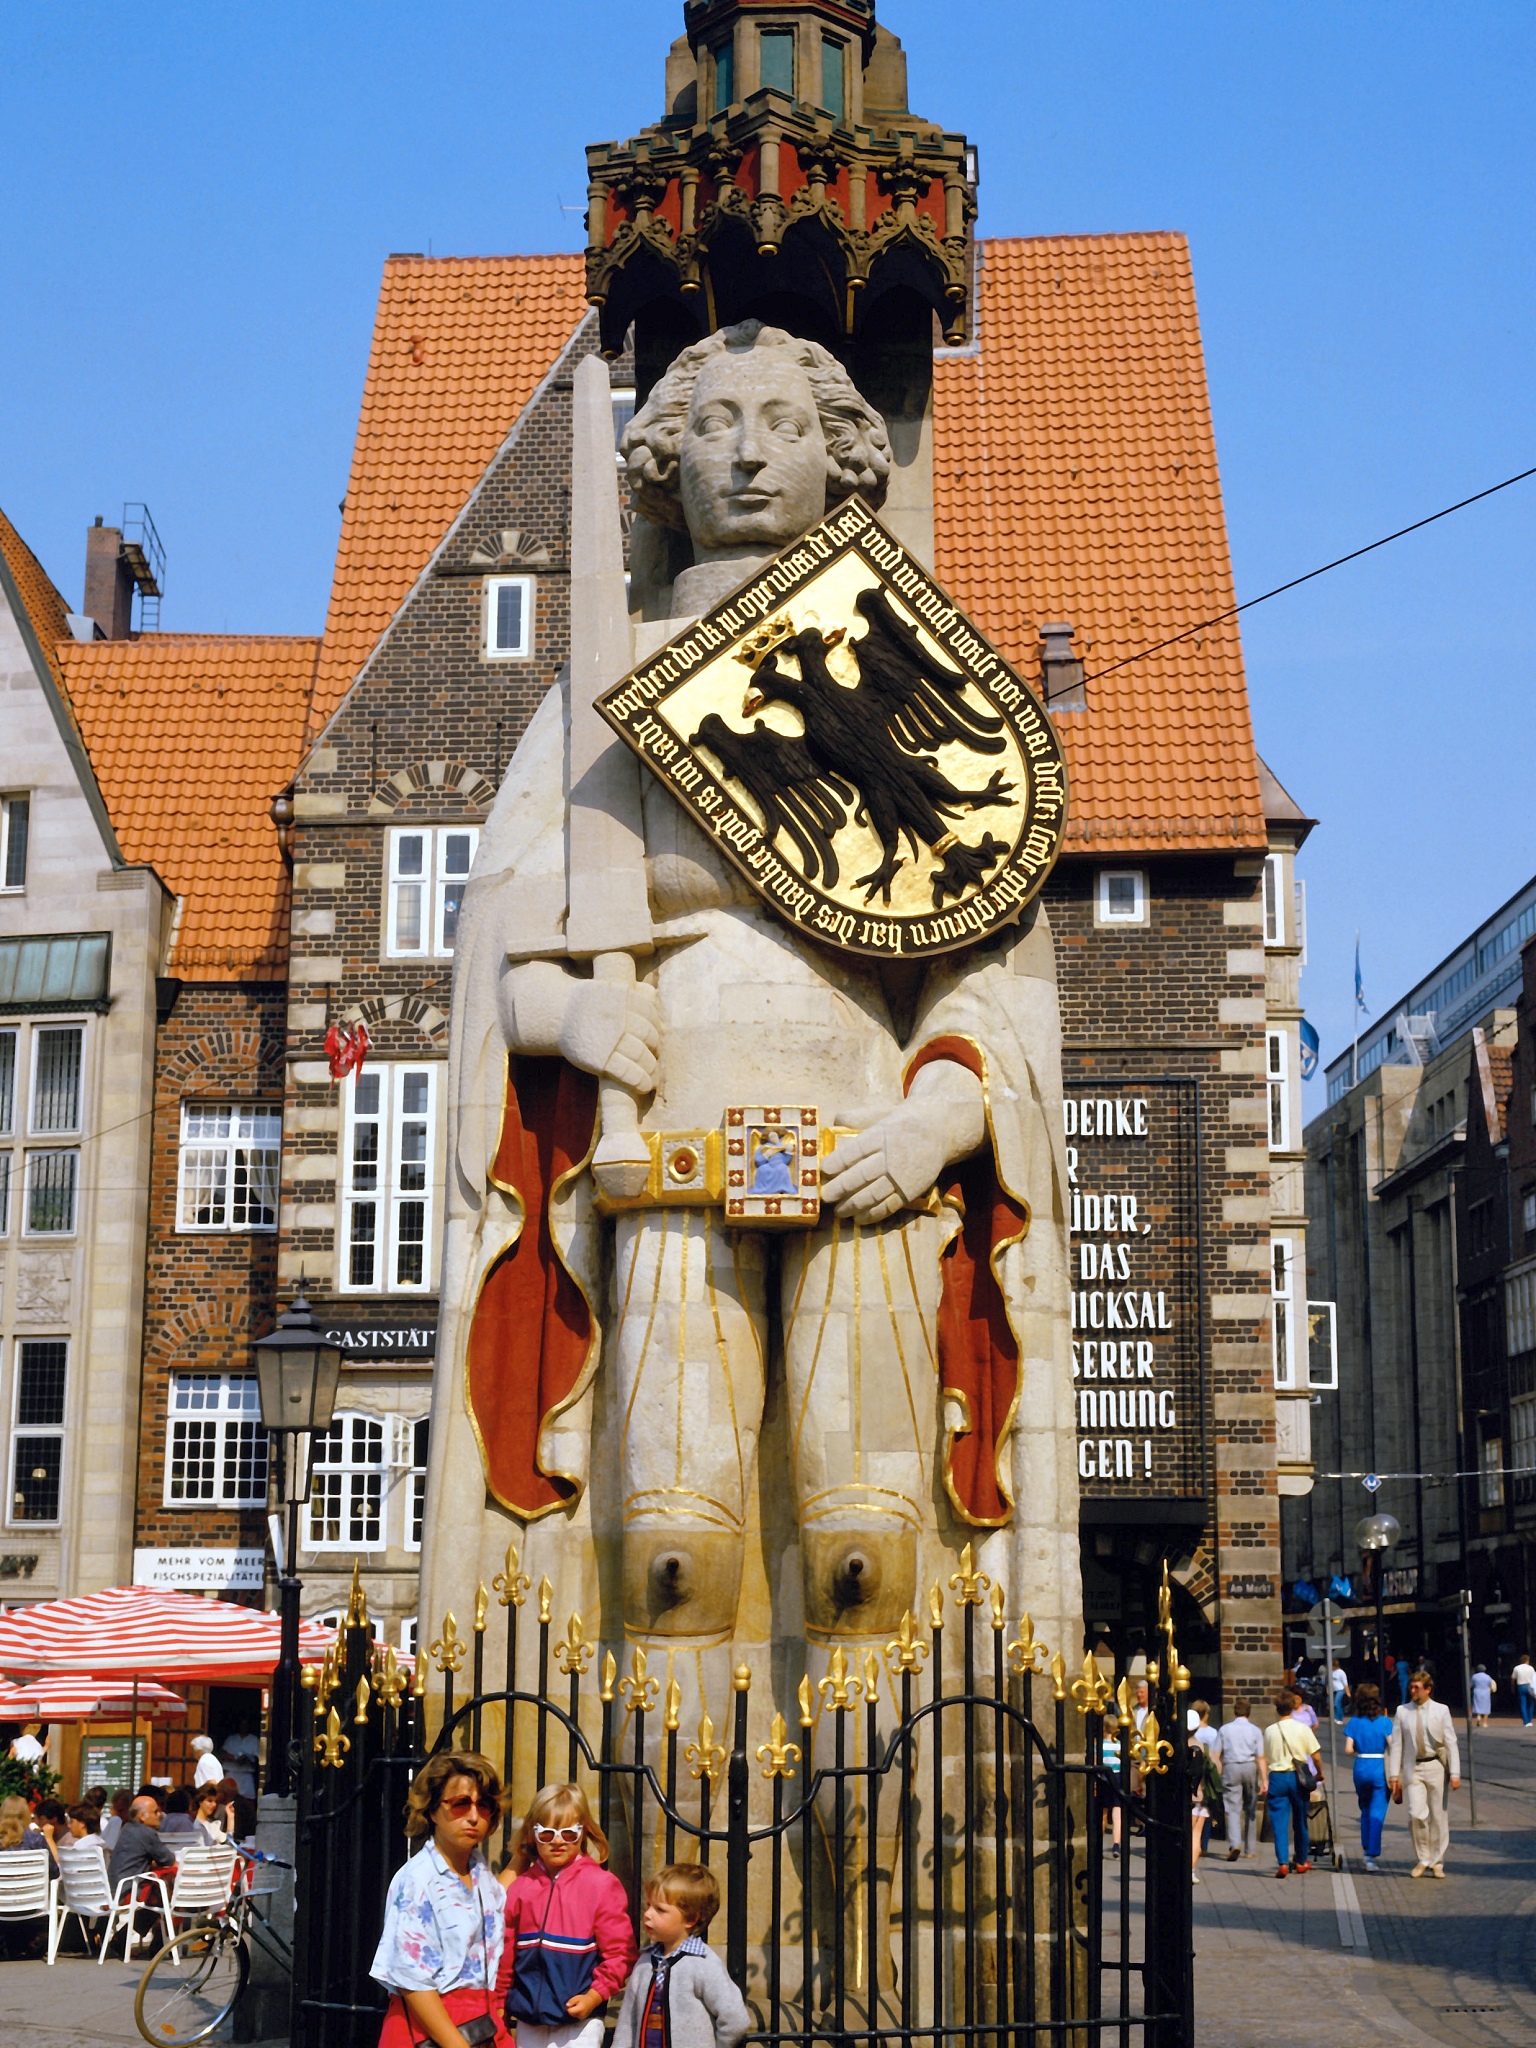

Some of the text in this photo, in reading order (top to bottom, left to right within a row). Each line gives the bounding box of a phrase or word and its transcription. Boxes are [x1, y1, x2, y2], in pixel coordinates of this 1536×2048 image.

[1081, 1243, 1131, 1280] DAS
[1074, 1390, 1175, 1427] NNUNG
[1079, 1440, 1133, 1477] GEN
[153, 1571, 264, 1581] FISCHSPEZIALITÄTE
[157, 1557, 264, 1566] MEHR VOM MEER
